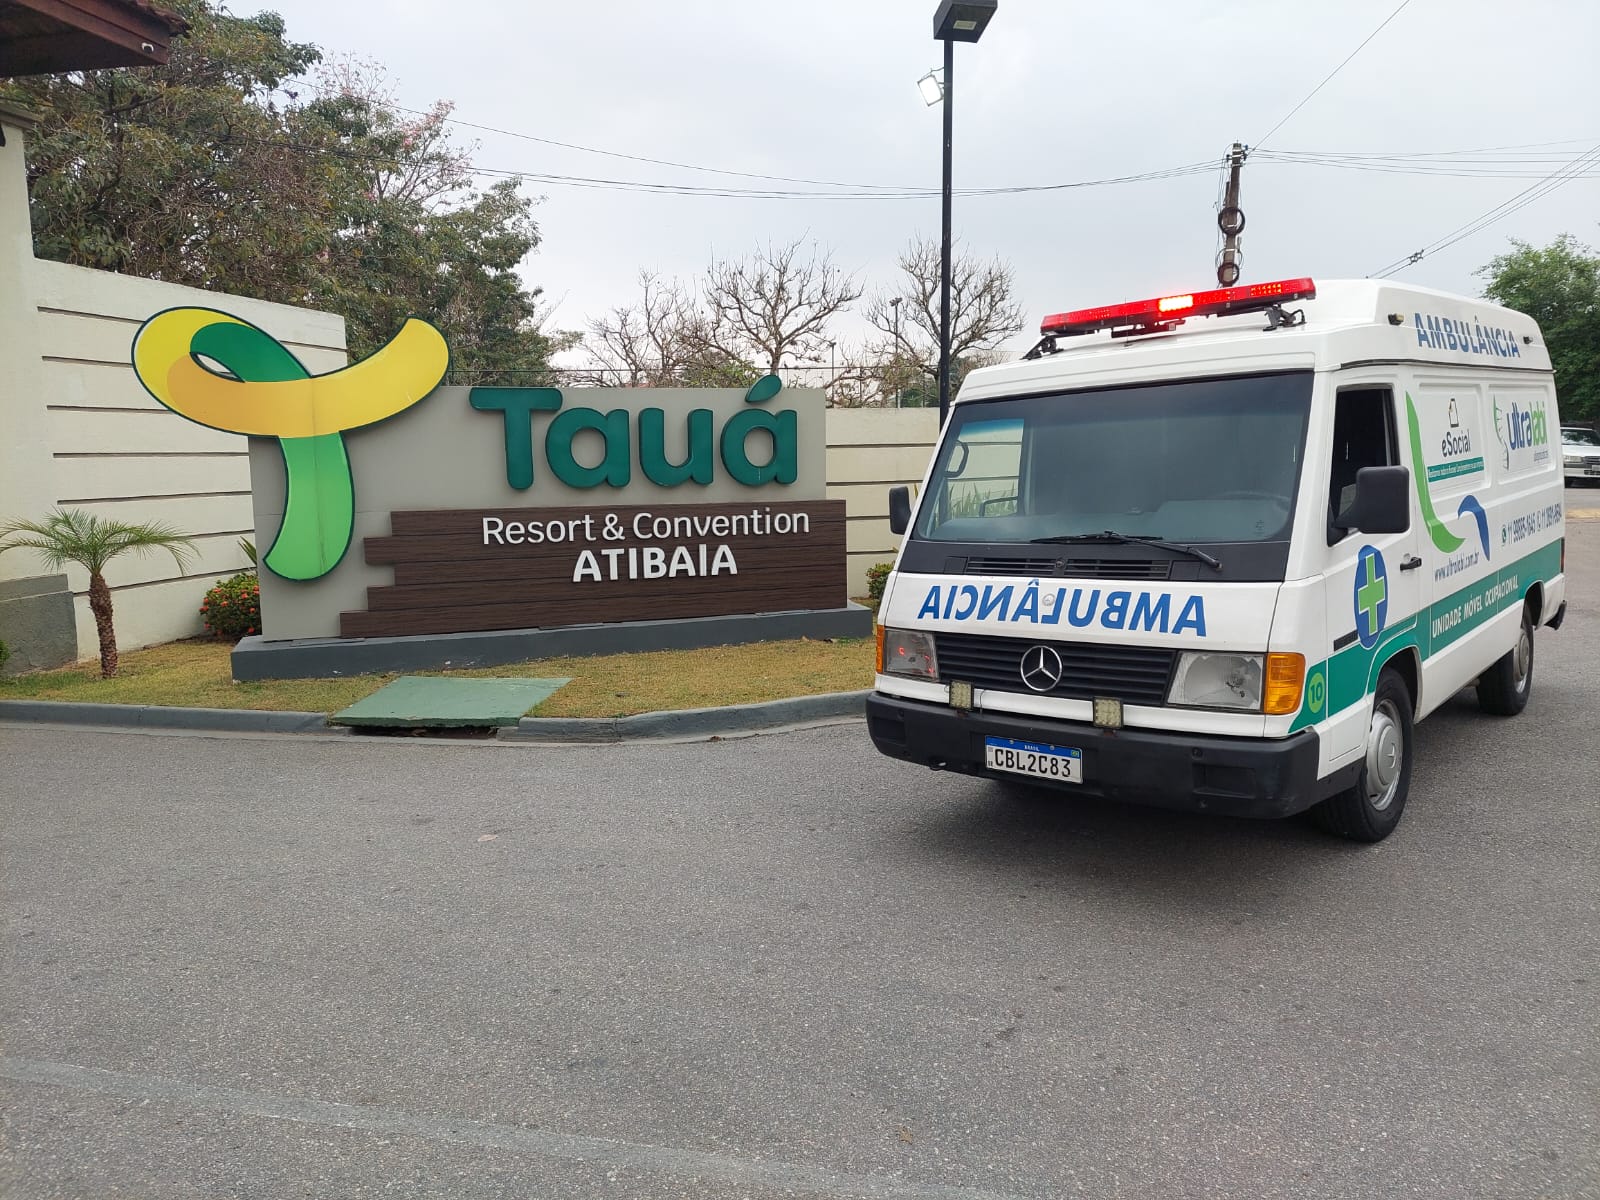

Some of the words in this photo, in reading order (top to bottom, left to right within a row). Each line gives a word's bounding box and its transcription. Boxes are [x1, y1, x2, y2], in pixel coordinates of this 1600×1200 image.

[1414, 312, 1521, 358] AMBULÂNCIA
[468, 374, 798, 490] Tauá
[1442, 429, 1471, 457] eSocial
[482, 513, 596, 545] Resort
[602, 513, 625, 541] &
[632, 507, 811, 540] Convention
[572, 543, 738, 583] ATIBAIA
[1432, 606, 1462, 638] UNIDADE
[1463, 593, 1483, 621] MÓVEL
[1484, 576, 1519, 607] OCUPACIONAL
[1310, 682, 1323, 704] 10
[994, 749, 1071, 778] CBL2C83
